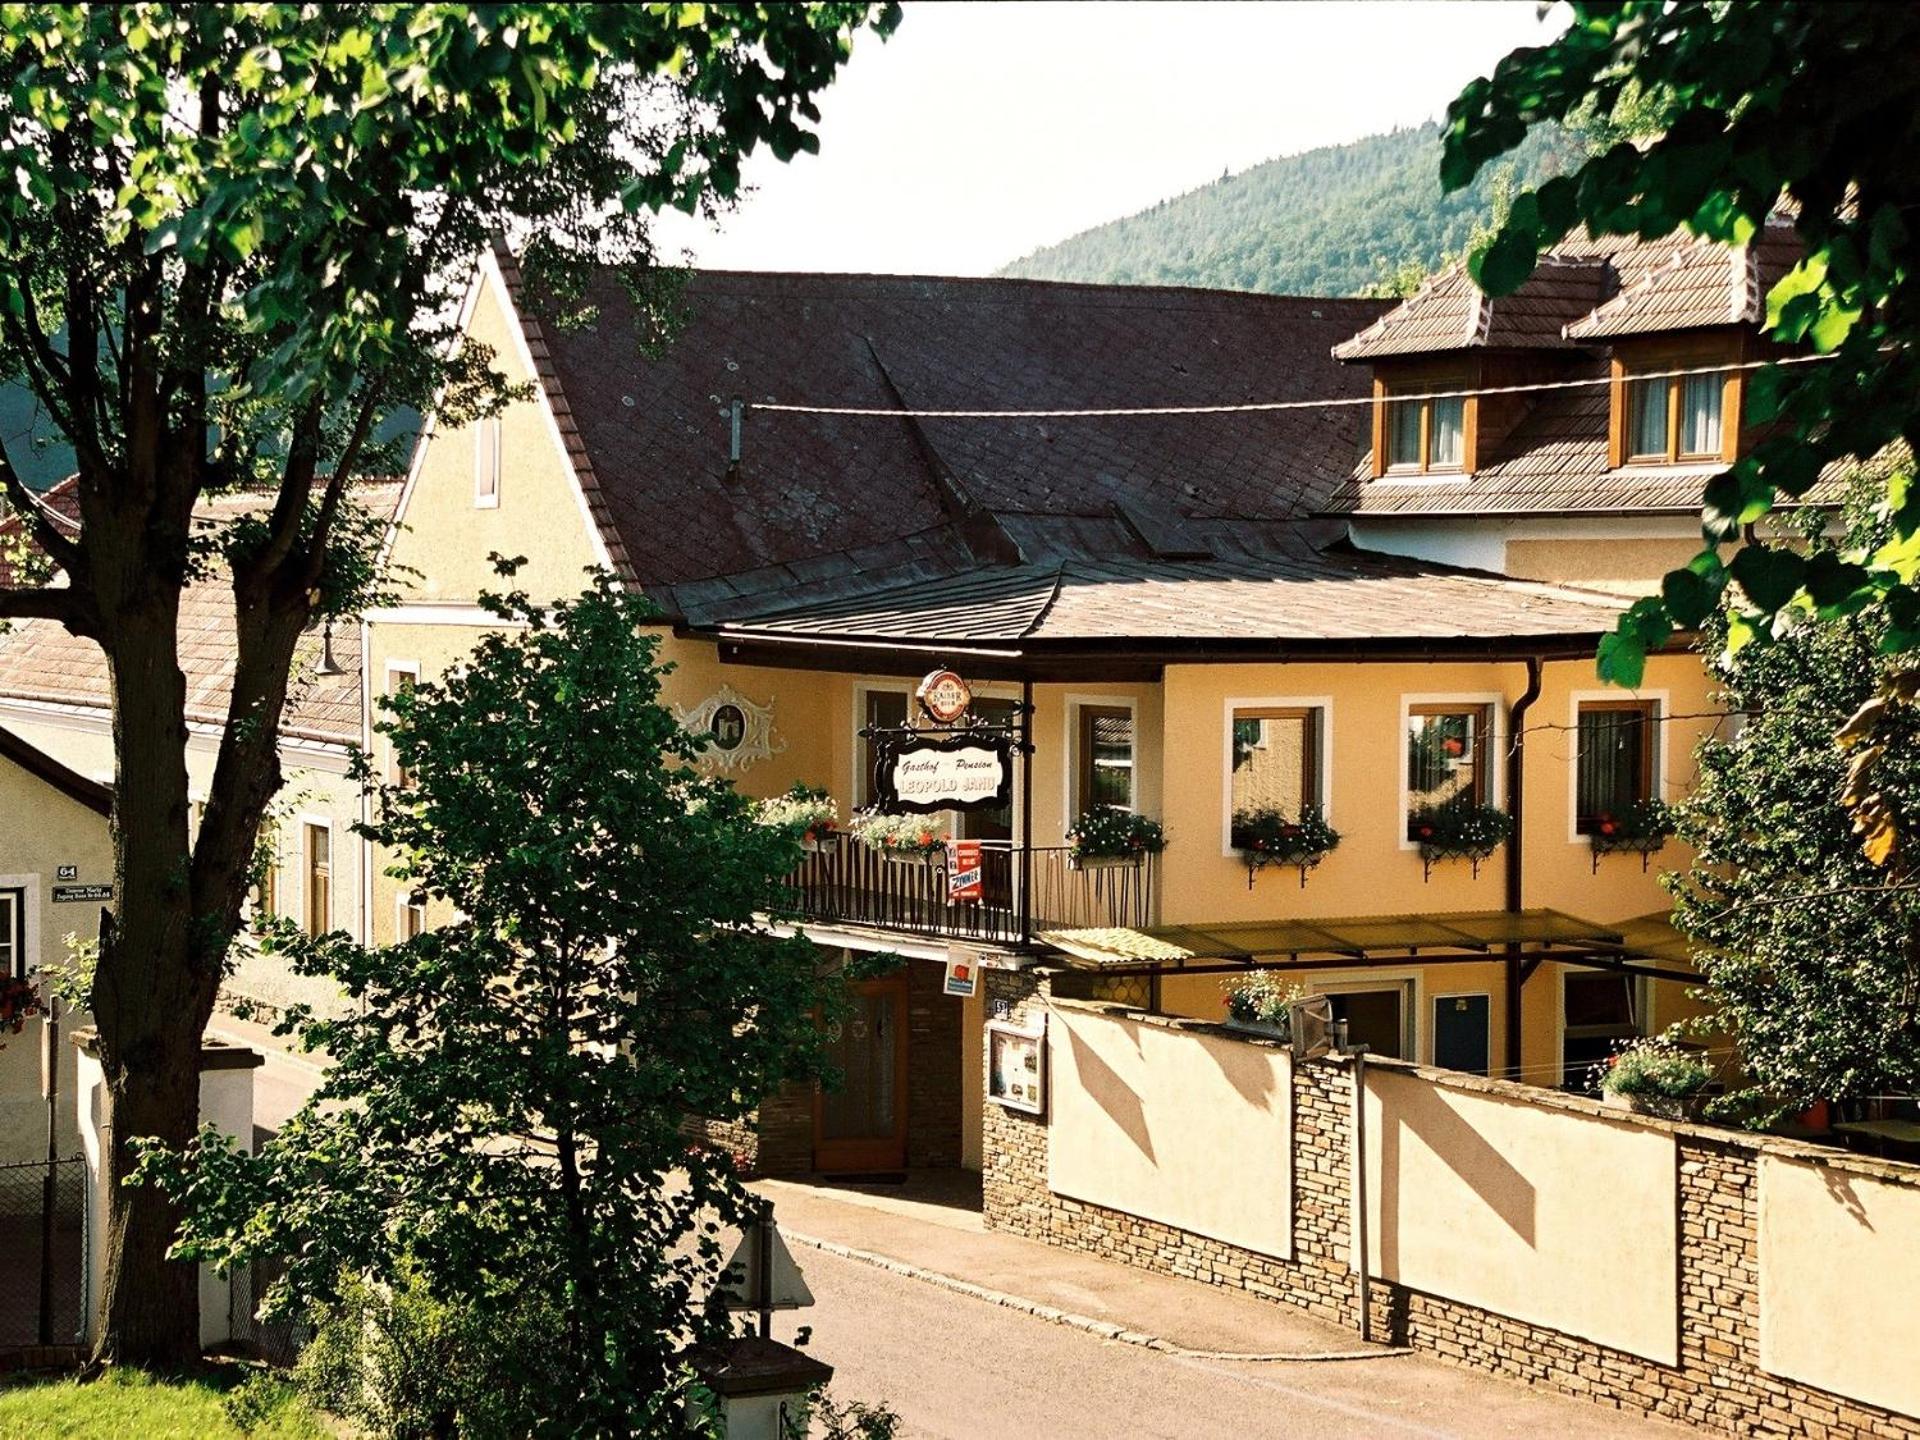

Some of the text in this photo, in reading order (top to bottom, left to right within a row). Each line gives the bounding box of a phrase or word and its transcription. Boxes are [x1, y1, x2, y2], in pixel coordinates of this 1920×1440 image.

[902, 758, 993, 776] Gasthof Pension
[901, 780, 957, 794] LEOPOLD
[60, 867, 75, 876] 64
